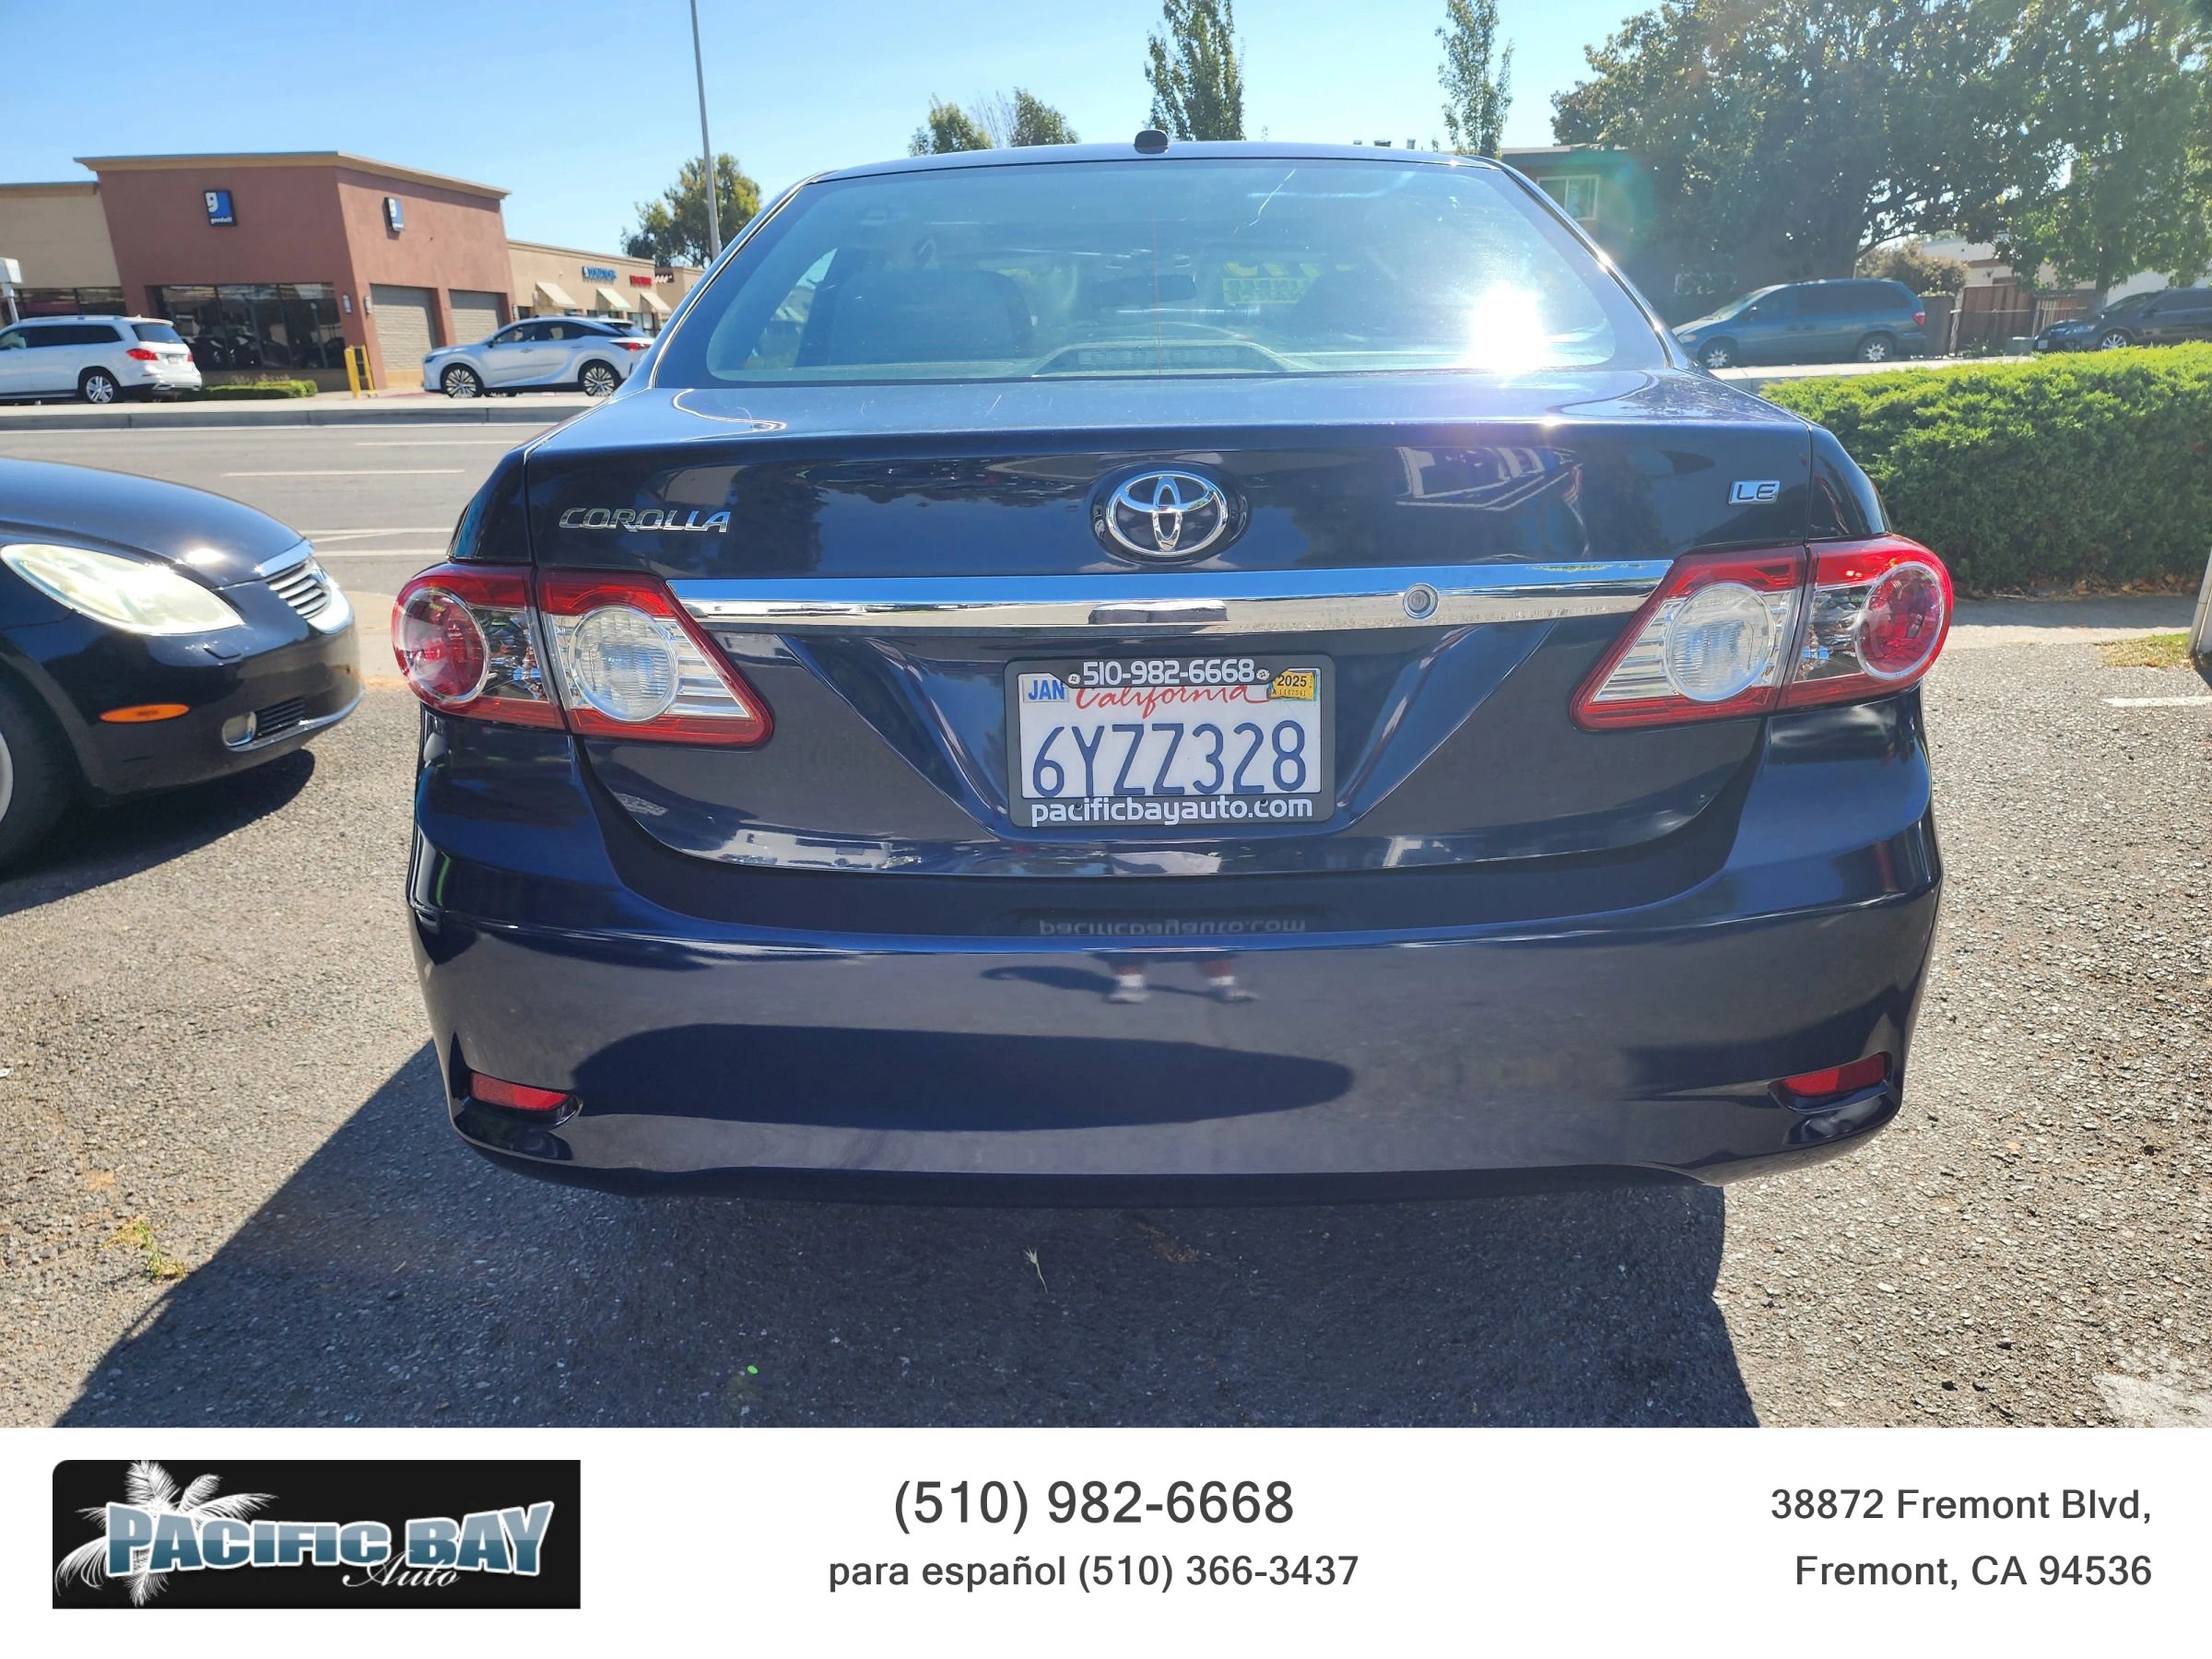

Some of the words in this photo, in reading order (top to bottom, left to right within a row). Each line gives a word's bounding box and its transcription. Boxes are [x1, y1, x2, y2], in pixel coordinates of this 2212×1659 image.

[1736, 484, 1776, 500] LE
[559, 508, 731, 533] COROLLA
[1082, 659, 1255, 686] 510-982-6668
[1277, 675, 1307, 688] 2025
[1028, 679, 1065, 701] JAN
[1076, 685, 1270, 719] California
[1032, 720, 1307, 798] 6YZZ328
[1031, 795, 1312, 828] pacificbayauto.com
